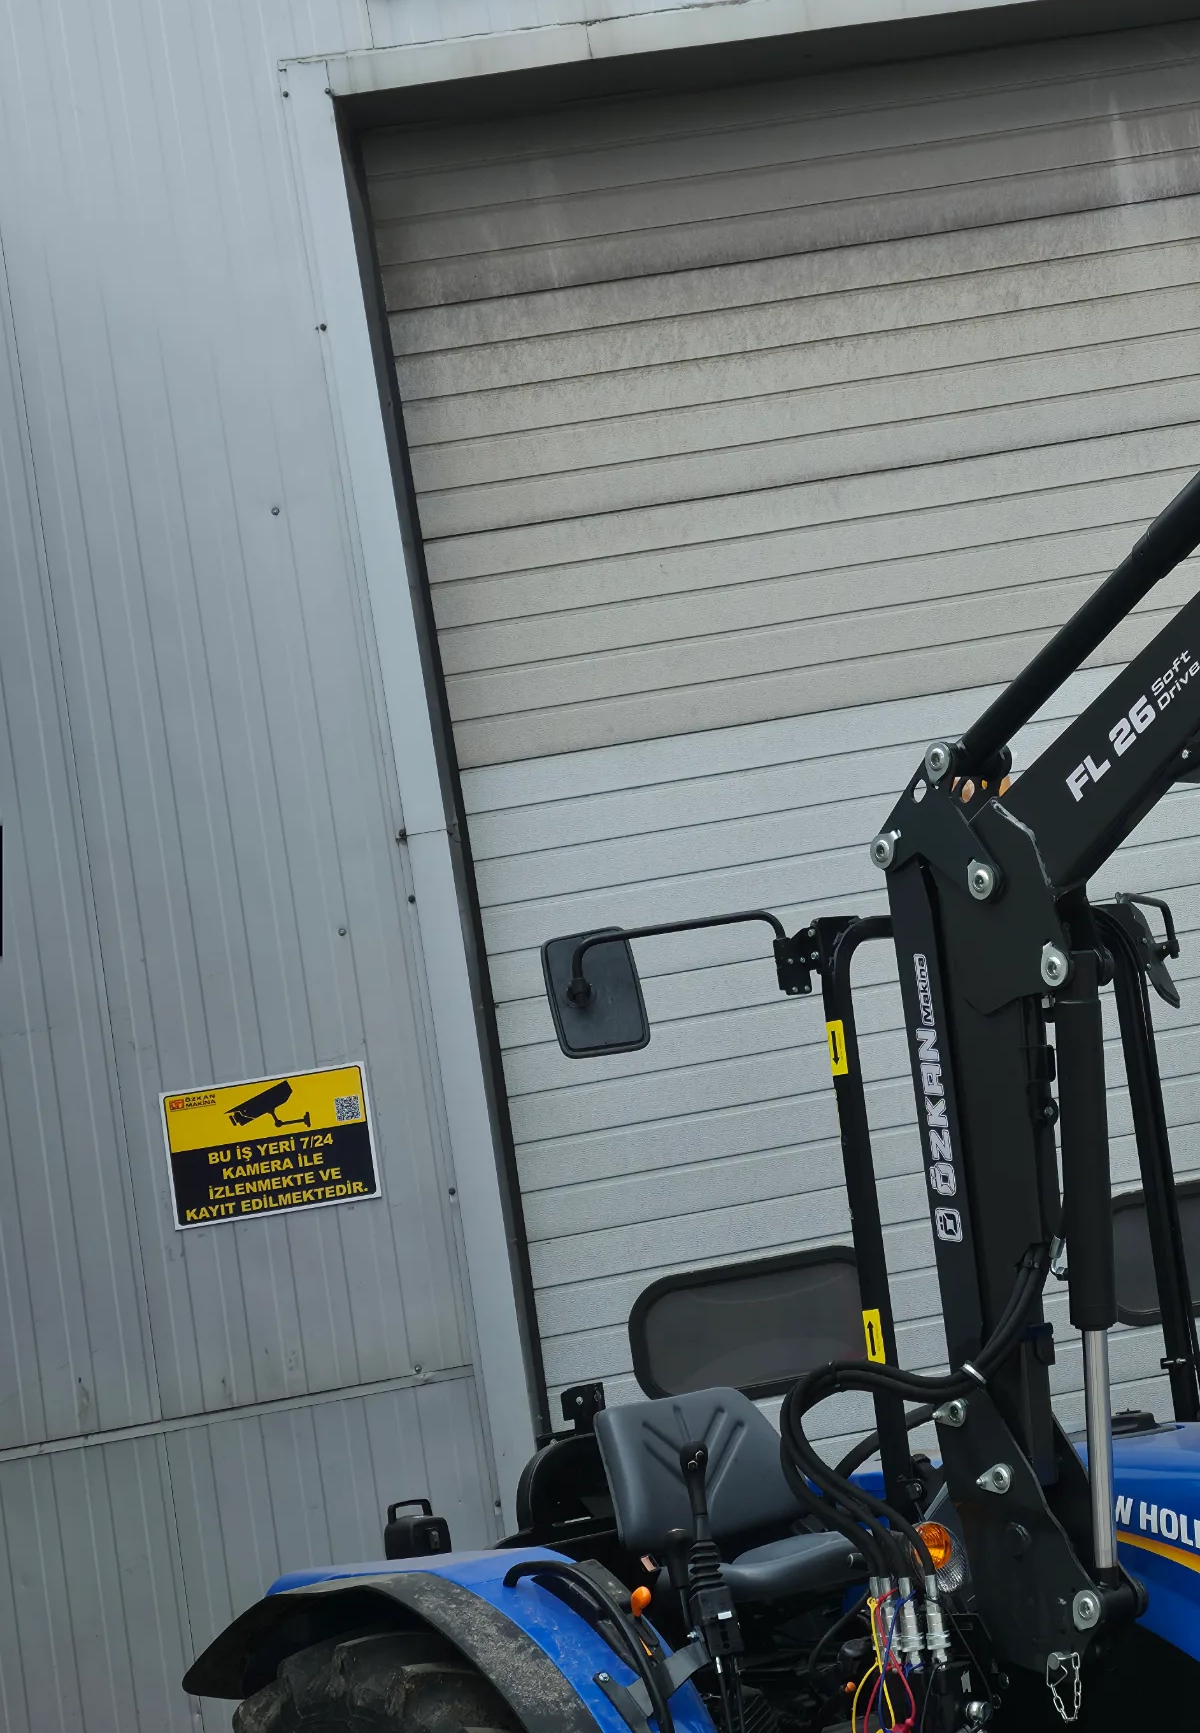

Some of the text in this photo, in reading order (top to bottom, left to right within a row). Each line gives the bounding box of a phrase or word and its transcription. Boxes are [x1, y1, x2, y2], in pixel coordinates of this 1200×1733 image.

[1151, 650, 1192, 696] Soft
[1157, 660, 1200, 711] Drive
[1065, 695, 1156, 803] FL 26
[915, 955, 936, 1025] Makina
[915, 1028, 957, 1196] ÖZKAN
[208, 1133, 334, 1165] BU İŞ YERİ 7/24
[222, 1152, 324, 1180] KAMERA İLE
[186, 1180, 369, 1222] KAYIT EDİLMEKTEDİR.
[208, 1167, 342, 1200] İZLENMEKTE VE
